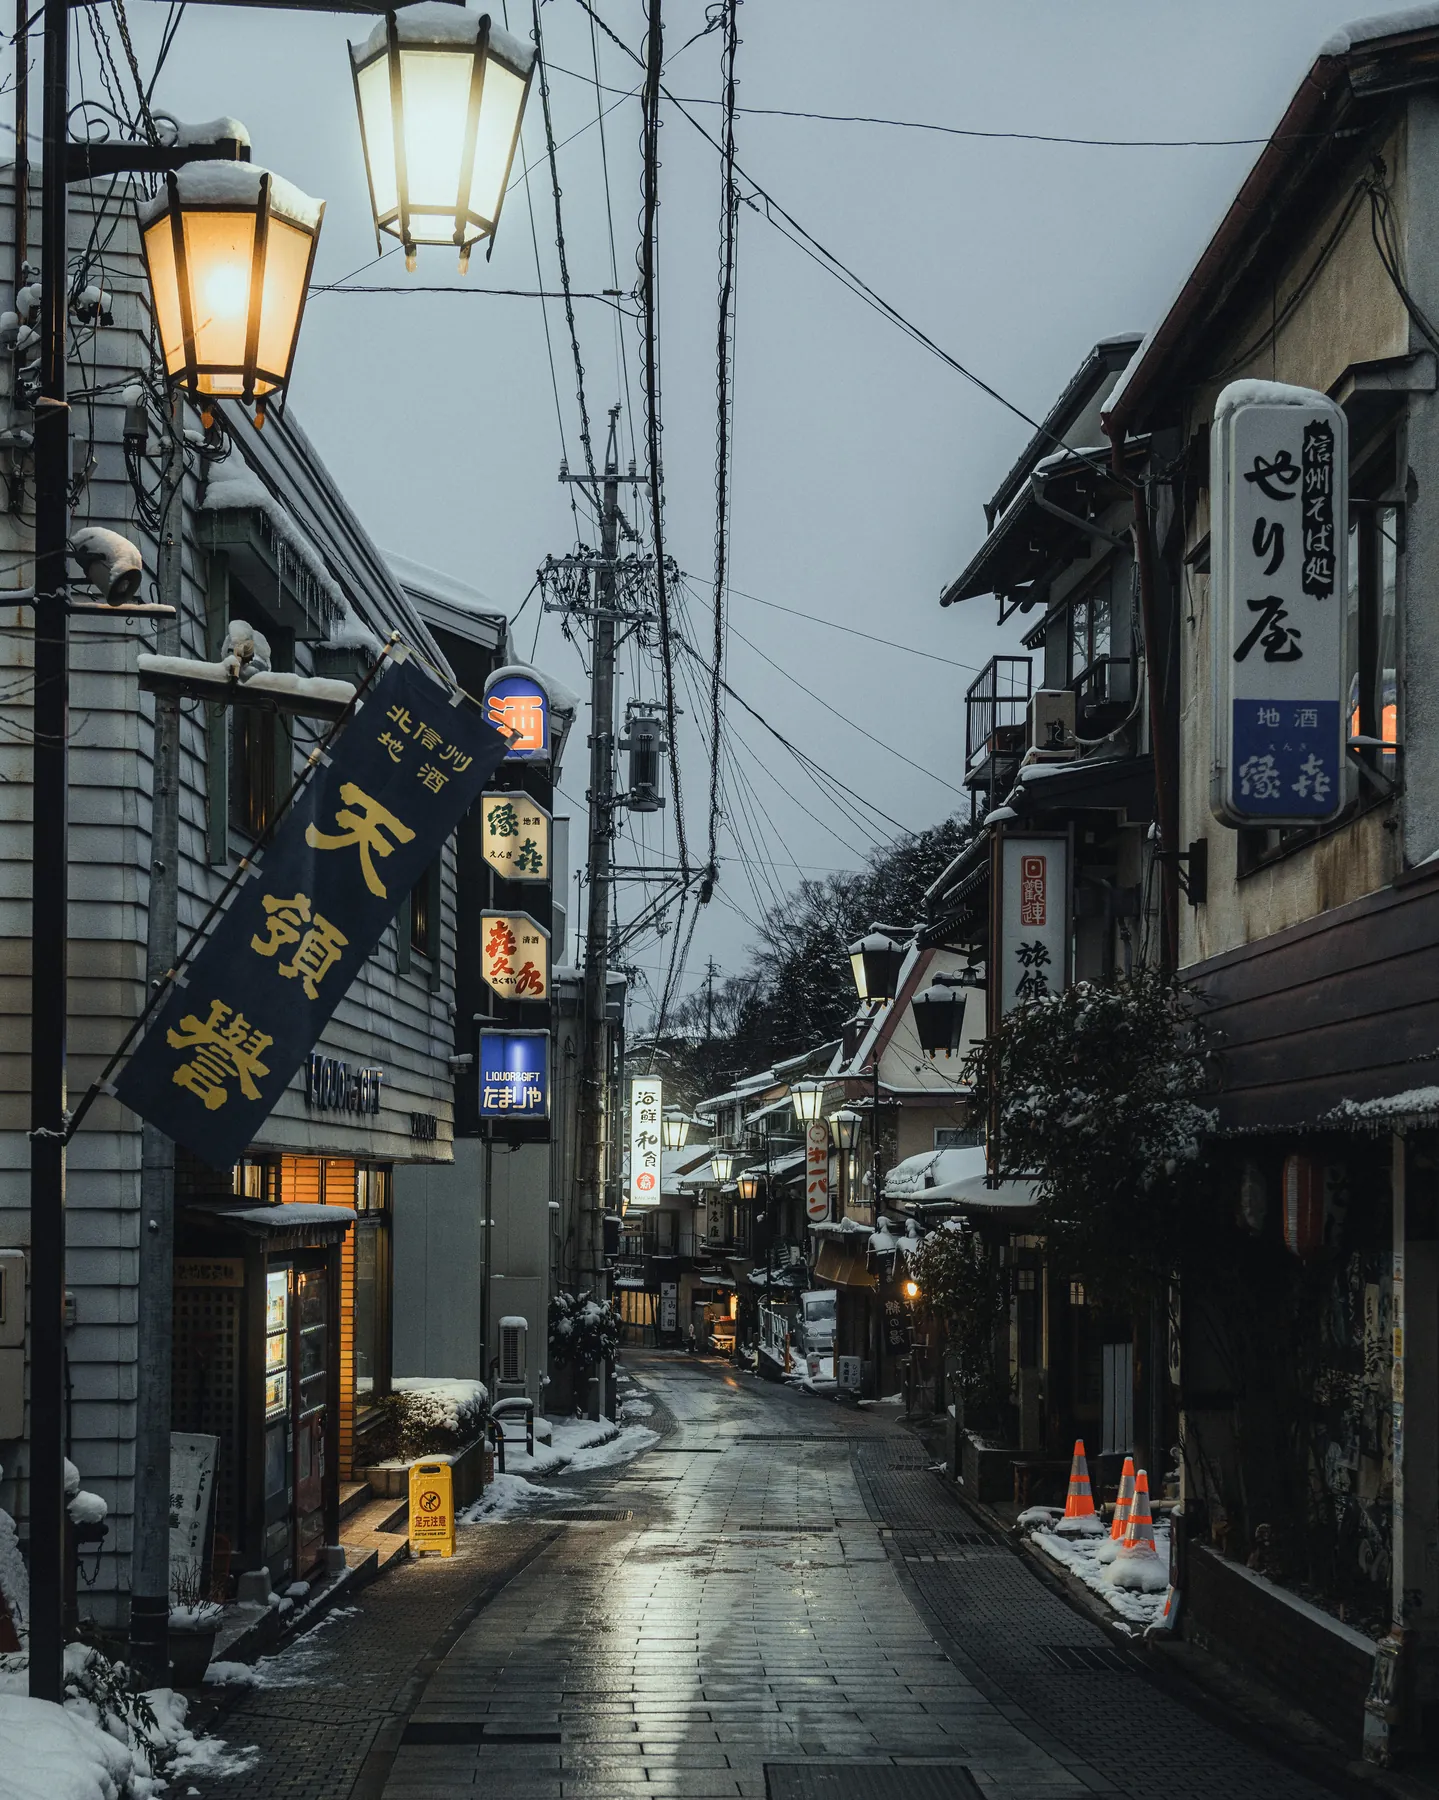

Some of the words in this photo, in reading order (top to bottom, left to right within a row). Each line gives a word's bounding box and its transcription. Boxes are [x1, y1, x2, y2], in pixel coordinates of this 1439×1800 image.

[1304, 435, 1333, 585] 信州そば処
[1233, 450, 1303, 662] やり屋
[488, 696, 543, 750] 酒
[1256, 707, 1318, 728] 地酒
[385, 704, 473, 773] 北信州
[377, 731, 450, 795] 地酒
[522, 817, 540, 826] 地酒
[489, 850, 513, 859] えんぎ
[522, 936, 539, 944] 清酒
[492, 977, 518, 985] きくすい
[1014, 940, 1052, 1000] 旅館
[485, 1071, 540, 1082] LIQUOR&GIFT
[483, 1086, 542, 1109] たまりや
[634, 1091, 658, 1168] 海鮮和食
[415, 1516, 447, 1527] 足元注意
